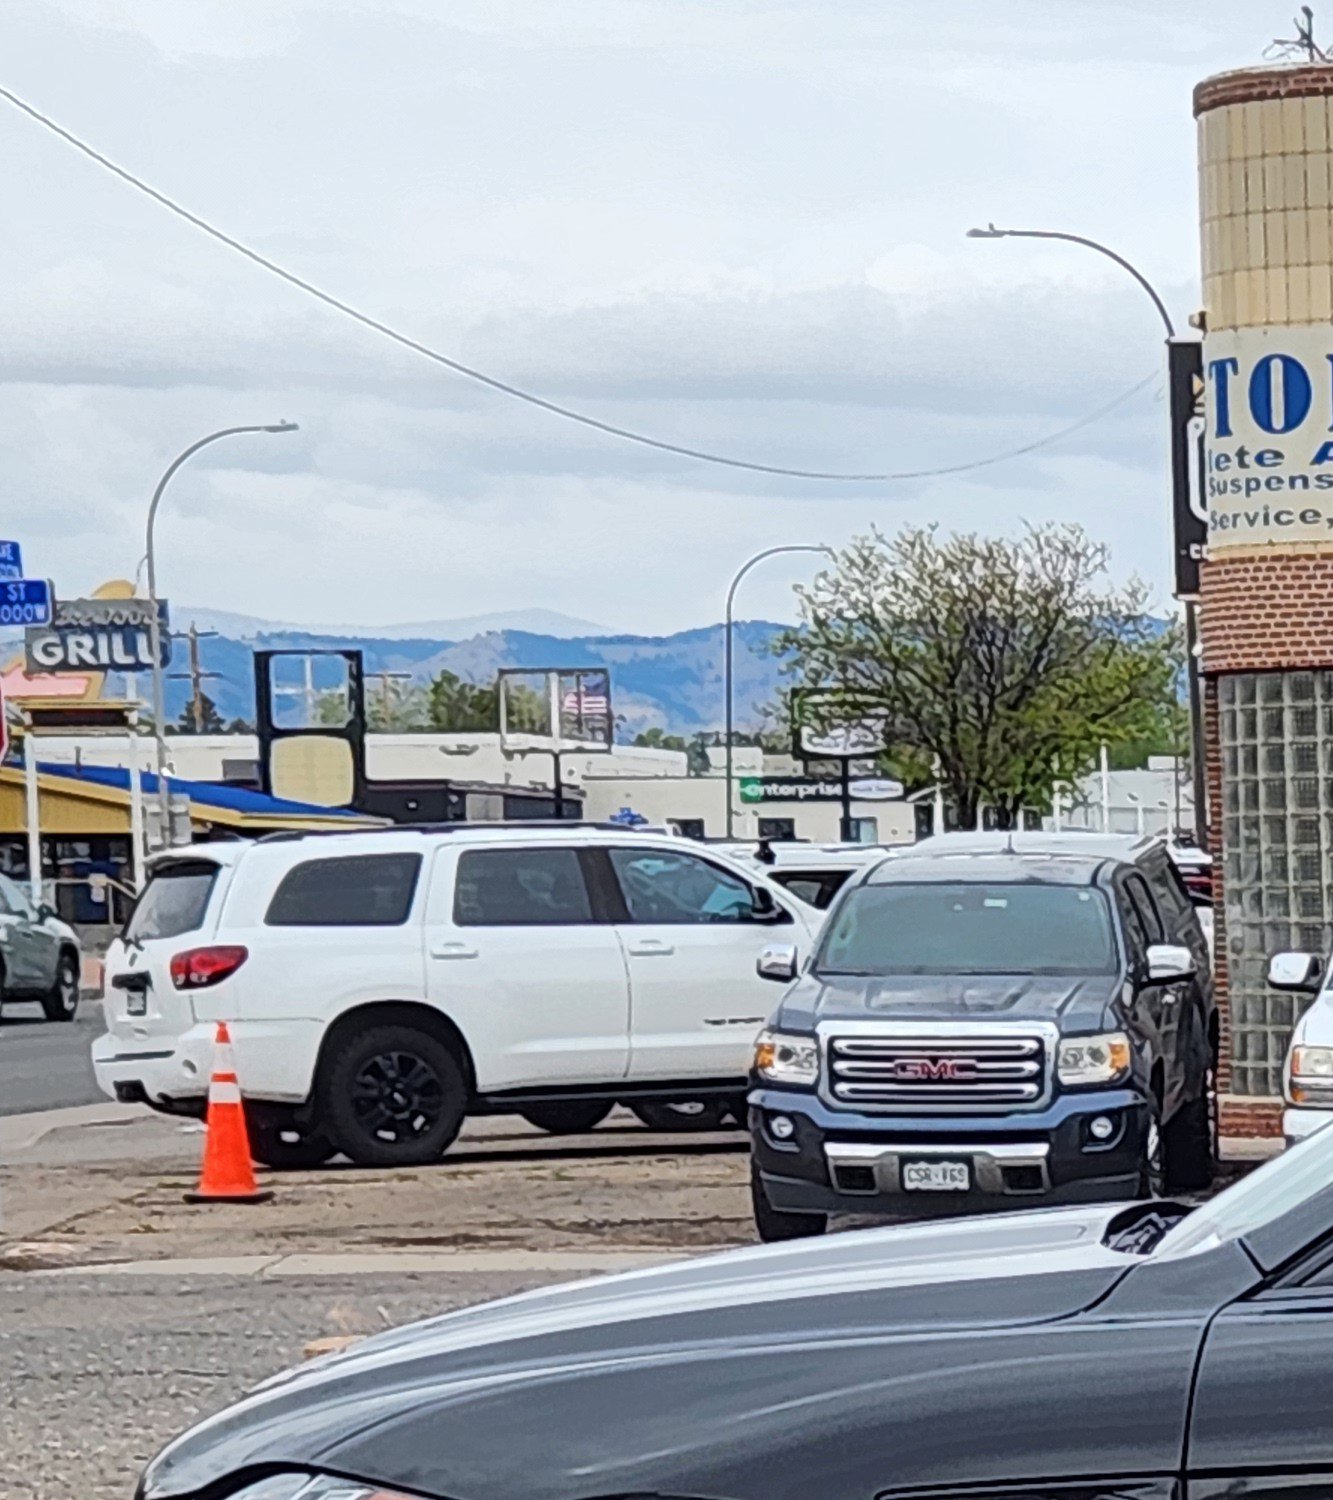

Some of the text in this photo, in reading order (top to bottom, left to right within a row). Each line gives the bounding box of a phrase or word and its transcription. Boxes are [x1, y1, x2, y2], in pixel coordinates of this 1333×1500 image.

[6, 583, 26, 601] ST
[32, 632, 156, 666] GRILL
[894, 1059, 977, 1080] GMC
